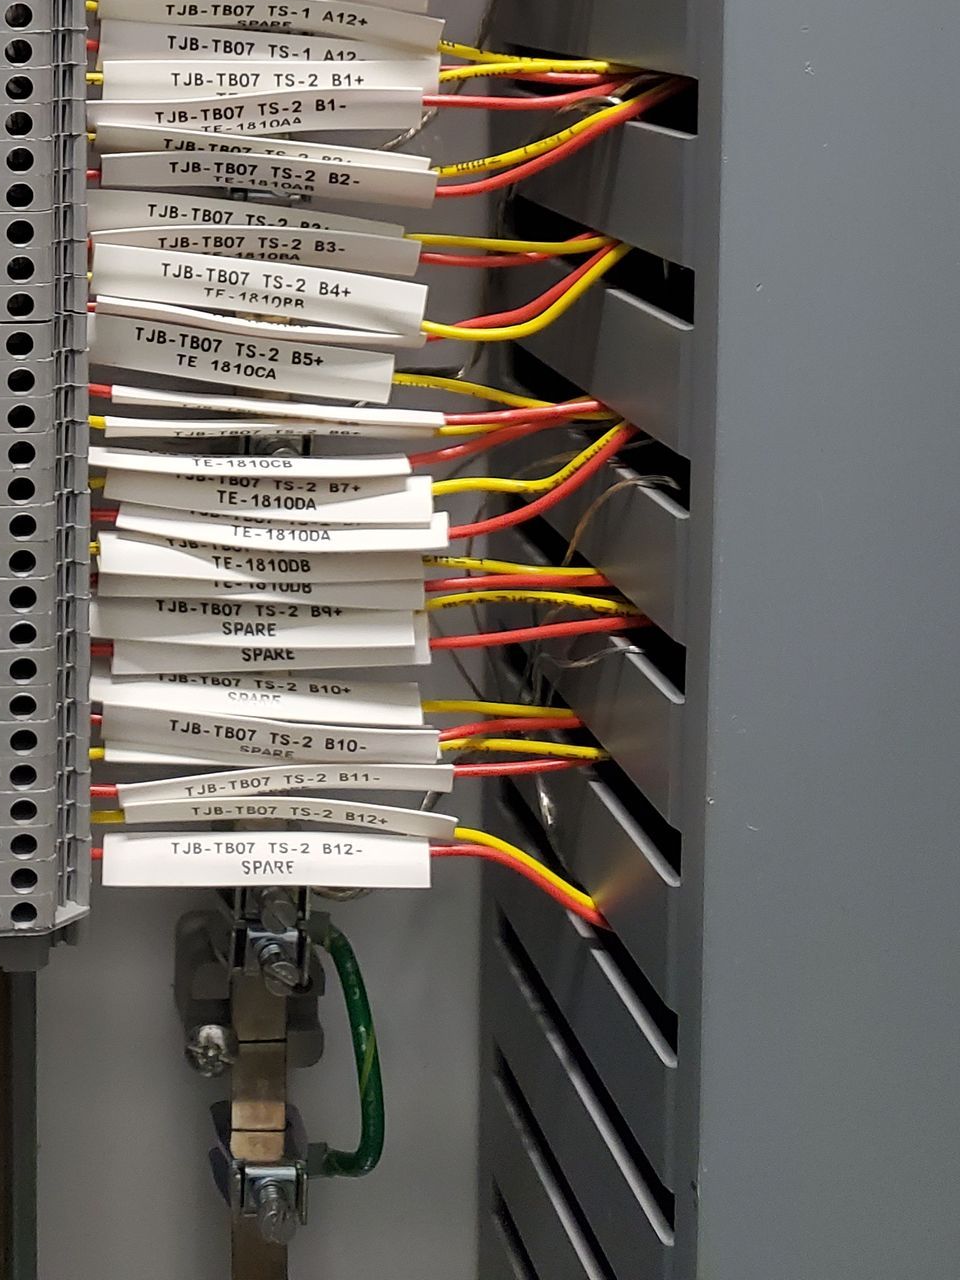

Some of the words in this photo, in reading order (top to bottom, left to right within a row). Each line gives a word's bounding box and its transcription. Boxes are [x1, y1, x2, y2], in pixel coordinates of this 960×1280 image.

[166, 5, 255, 16] TJB-TB07
[268, 6, 310, 19] TS-1
[323, 11, 368, 27] A12+
[168, 36, 255, 56] TJB-TB07
[268, 45, 311, 60] TS-1
[171, 72, 260, 87] TJB-TB07
[274, 74, 318, 87] TS-2
[332, 74, 364, 87] B1+
[155, 106, 244, 124] TJB-TB07
[258, 101, 302, 115] TS-2
[315, 99, 346, 112] B1-
[169, 162, 258, 176] TJB-TB07
[271, 167, 315, 182] TS-2
[329, 173, 360, 186] B2-
[148, 205, 234, 225] TJB-TB07
[158, 237, 245, 248] TJB-TB07
[258, 237, 301, 251] TS-2
[315, 241, 345, 254] B3-
[162, 263, 250, 286] TJB-TB07
[263, 275, 306, 292] TS-2
[319, 282, 351, 297] B4+
[136, 328, 223, 353] TJB-TB07
[236, 342, 279, 362] TS-2
[292, 351, 324, 367] B5+
[274, 480, 317, 492] TS-2
[329, 483, 361, 492] B7+
[217, 490, 317, 511] TE-1810DA
[212, 556, 311, 572] TE-1810DB
[156, 599, 241, 616] TJB-TB07
[256, 605, 298, 617] TS-2
[223, 622, 277, 637] SPARE
[254, 680, 297, 691] TS-2
[309, 684, 351, 695] B10+
[170, 720, 256, 741] TJB-TB07
[269, 732, 312, 748] TS-2
[325, 738, 367, 752] B10-
[185, 778, 270, 796] TJB-TB07
[284, 774, 327, 784] TS-2
[339, 772, 380, 782] B11-
[171, 842, 255, 854] TJB-TB07
[269, 842, 310, 854] TS-2
[322, 844, 362, 855] B12-
